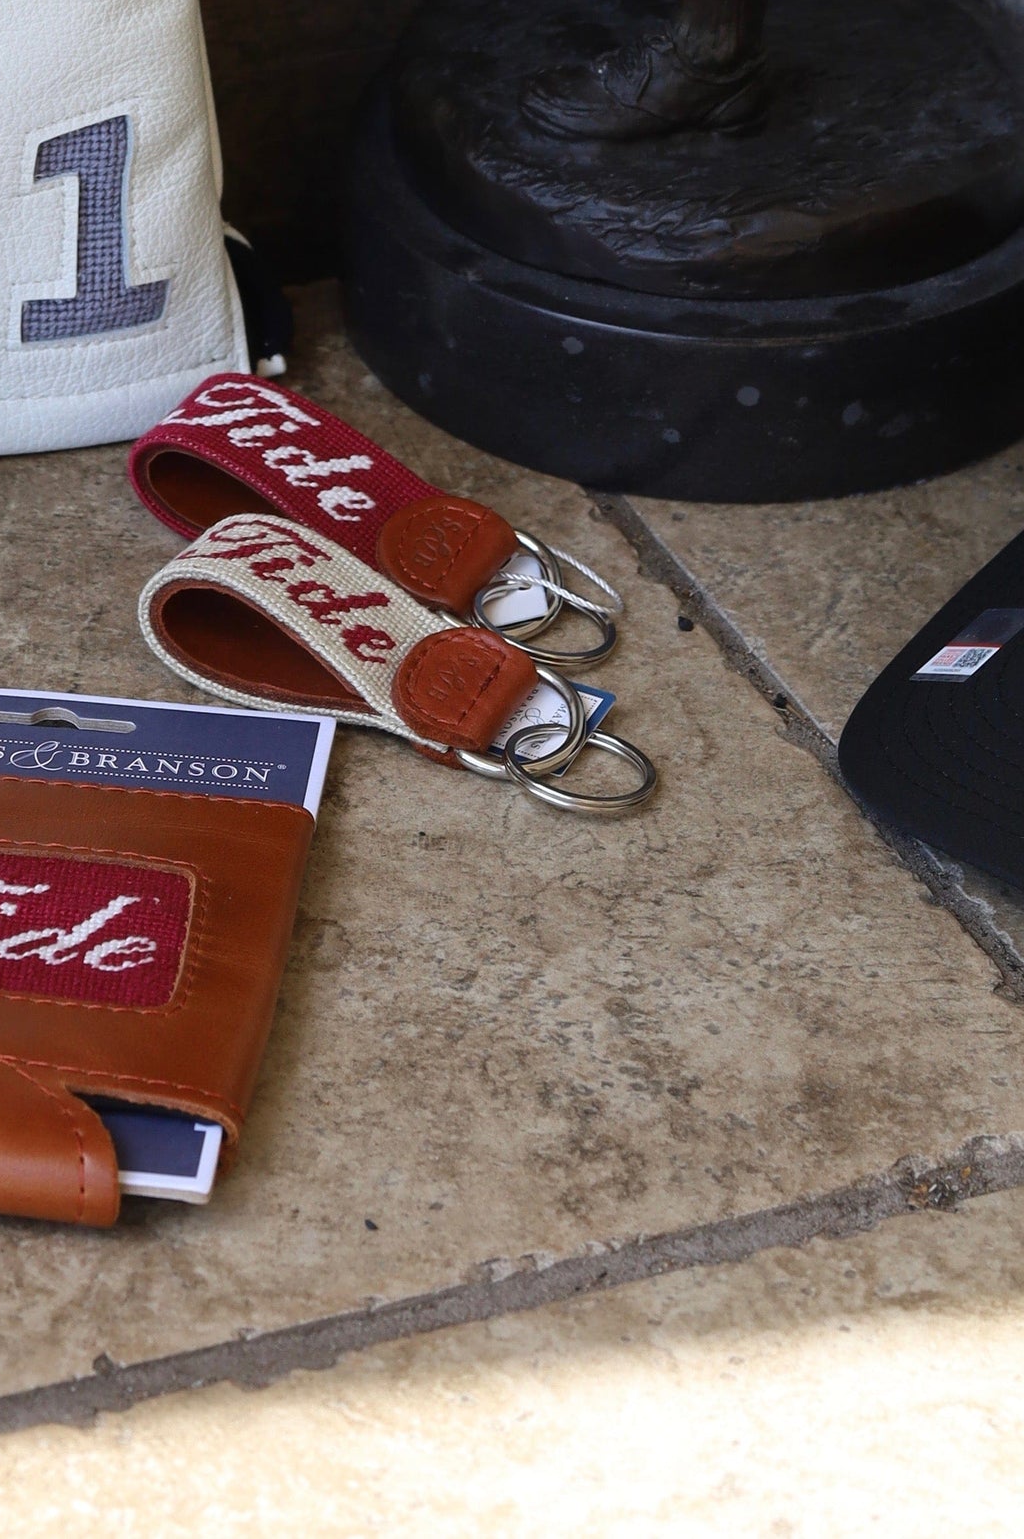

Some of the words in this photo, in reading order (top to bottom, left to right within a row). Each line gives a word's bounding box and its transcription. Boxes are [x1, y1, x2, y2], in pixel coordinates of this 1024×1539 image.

[20, 114, 170, 343] 1
[160, 381, 376, 522] Tide
[176, 519, 397, 664] Tide
